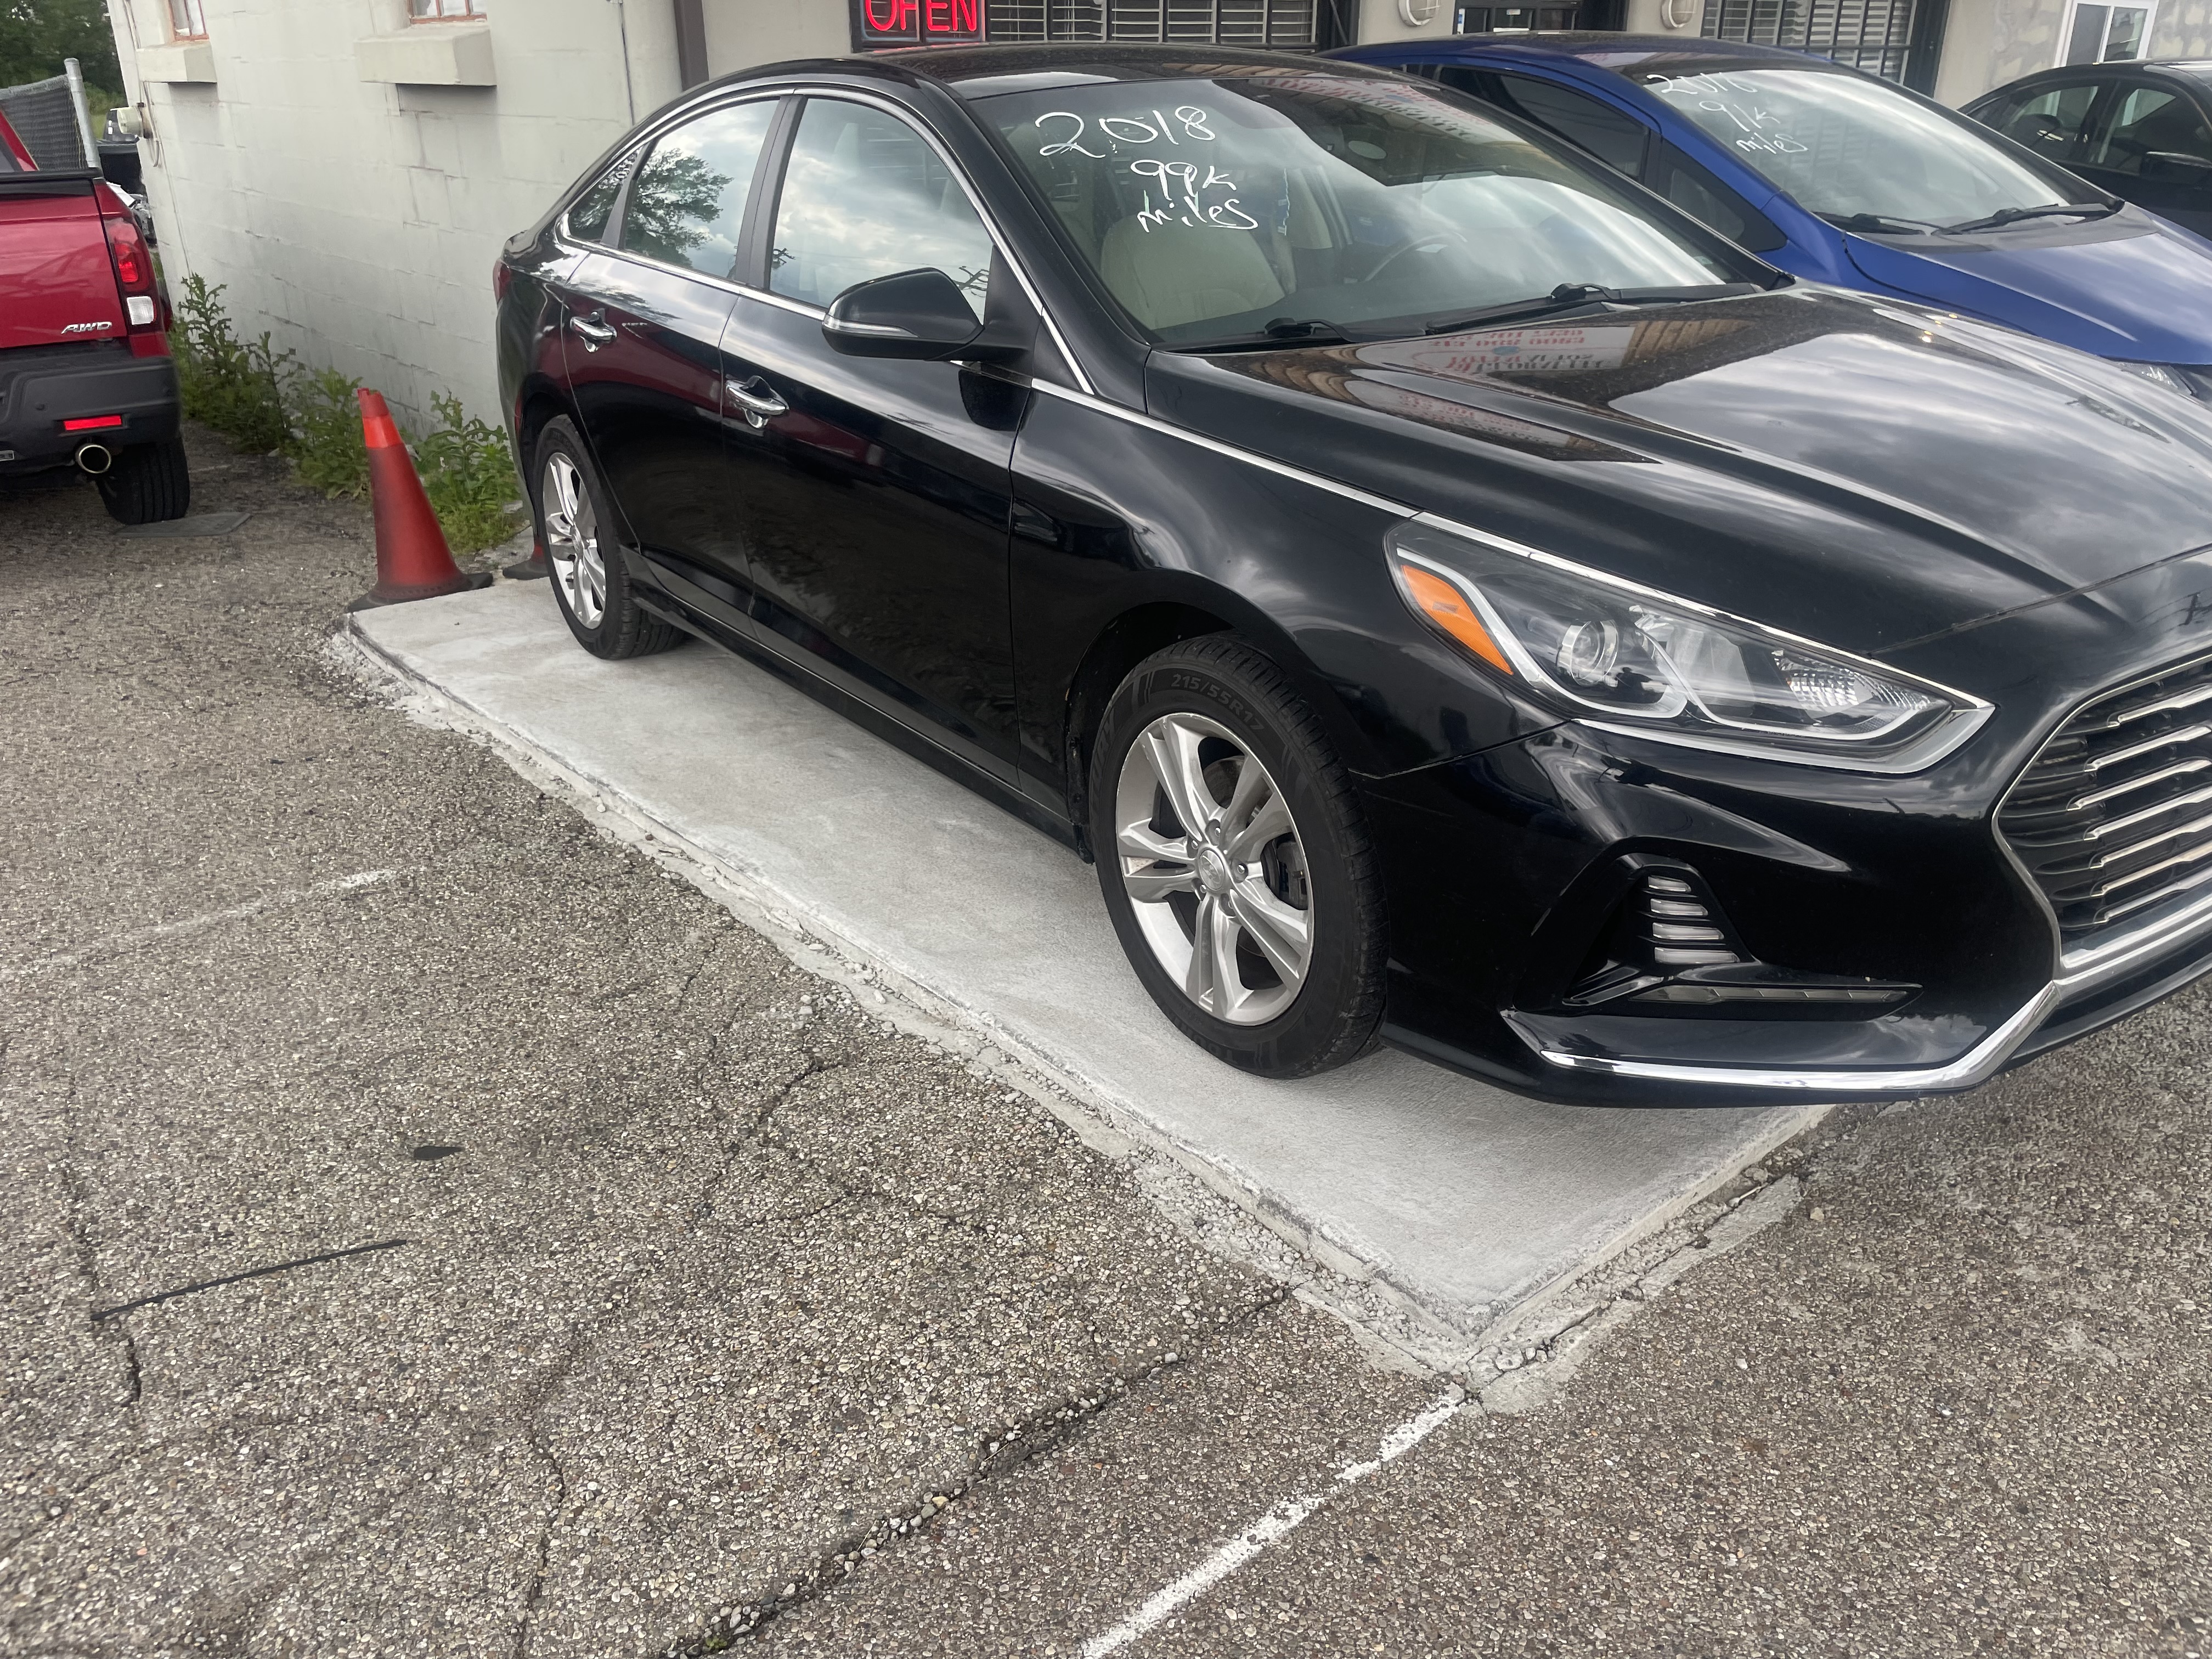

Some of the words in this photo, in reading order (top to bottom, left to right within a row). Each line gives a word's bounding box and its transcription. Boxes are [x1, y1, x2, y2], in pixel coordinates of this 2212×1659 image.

[865, 0, 977, 31] OPEN
[1035, 106, 1216, 158] 2018
[1736, 132, 1808, 154] miles
[60, 321, 112, 334] AWD
[1171, 674, 1265, 730] 215/55R17
